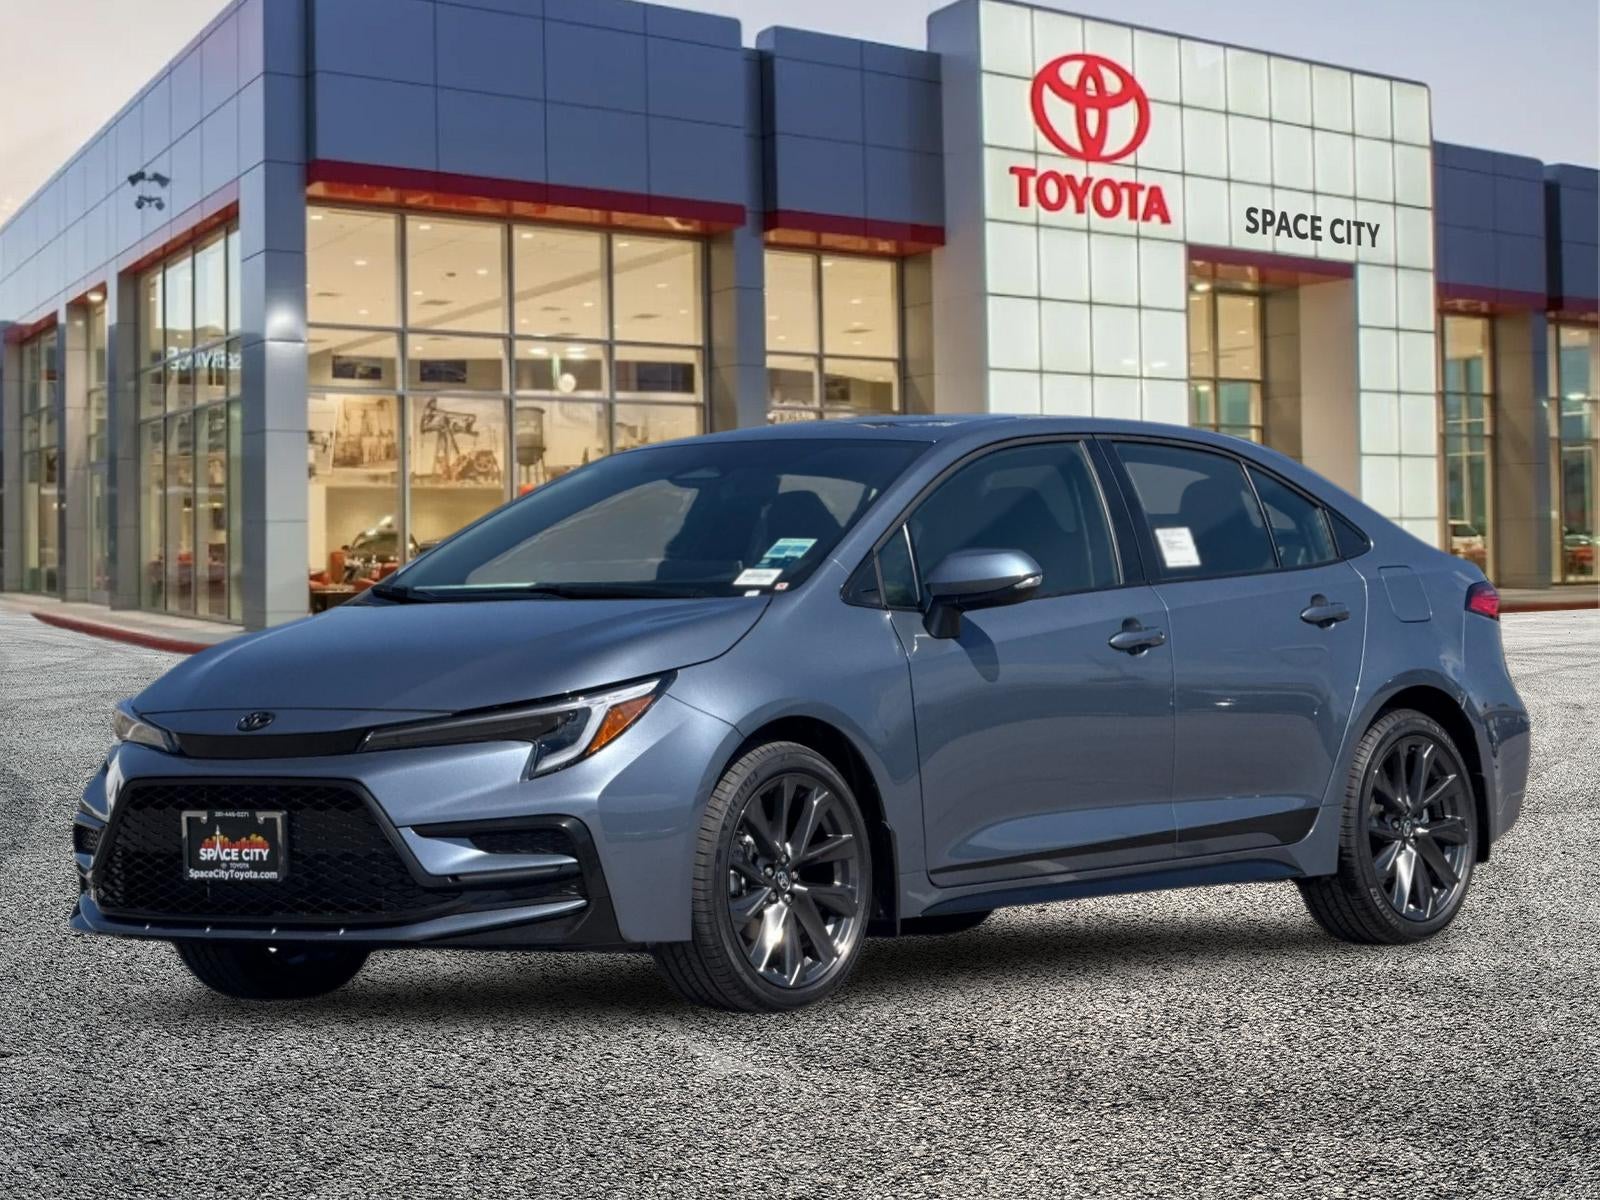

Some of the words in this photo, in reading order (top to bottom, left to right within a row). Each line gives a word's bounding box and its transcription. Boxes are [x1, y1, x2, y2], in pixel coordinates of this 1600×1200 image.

[1010, 166, 1171, 224] TOYOTA
[1245, 206, 1322, 241] SPACE
[1330, 218, 1381, 248] CITY
[199, 847, 239, 861] SPACE
[242, 848, 270, 861] CITY
[189, 869, 278, 880] SpaceCityToyota.com
